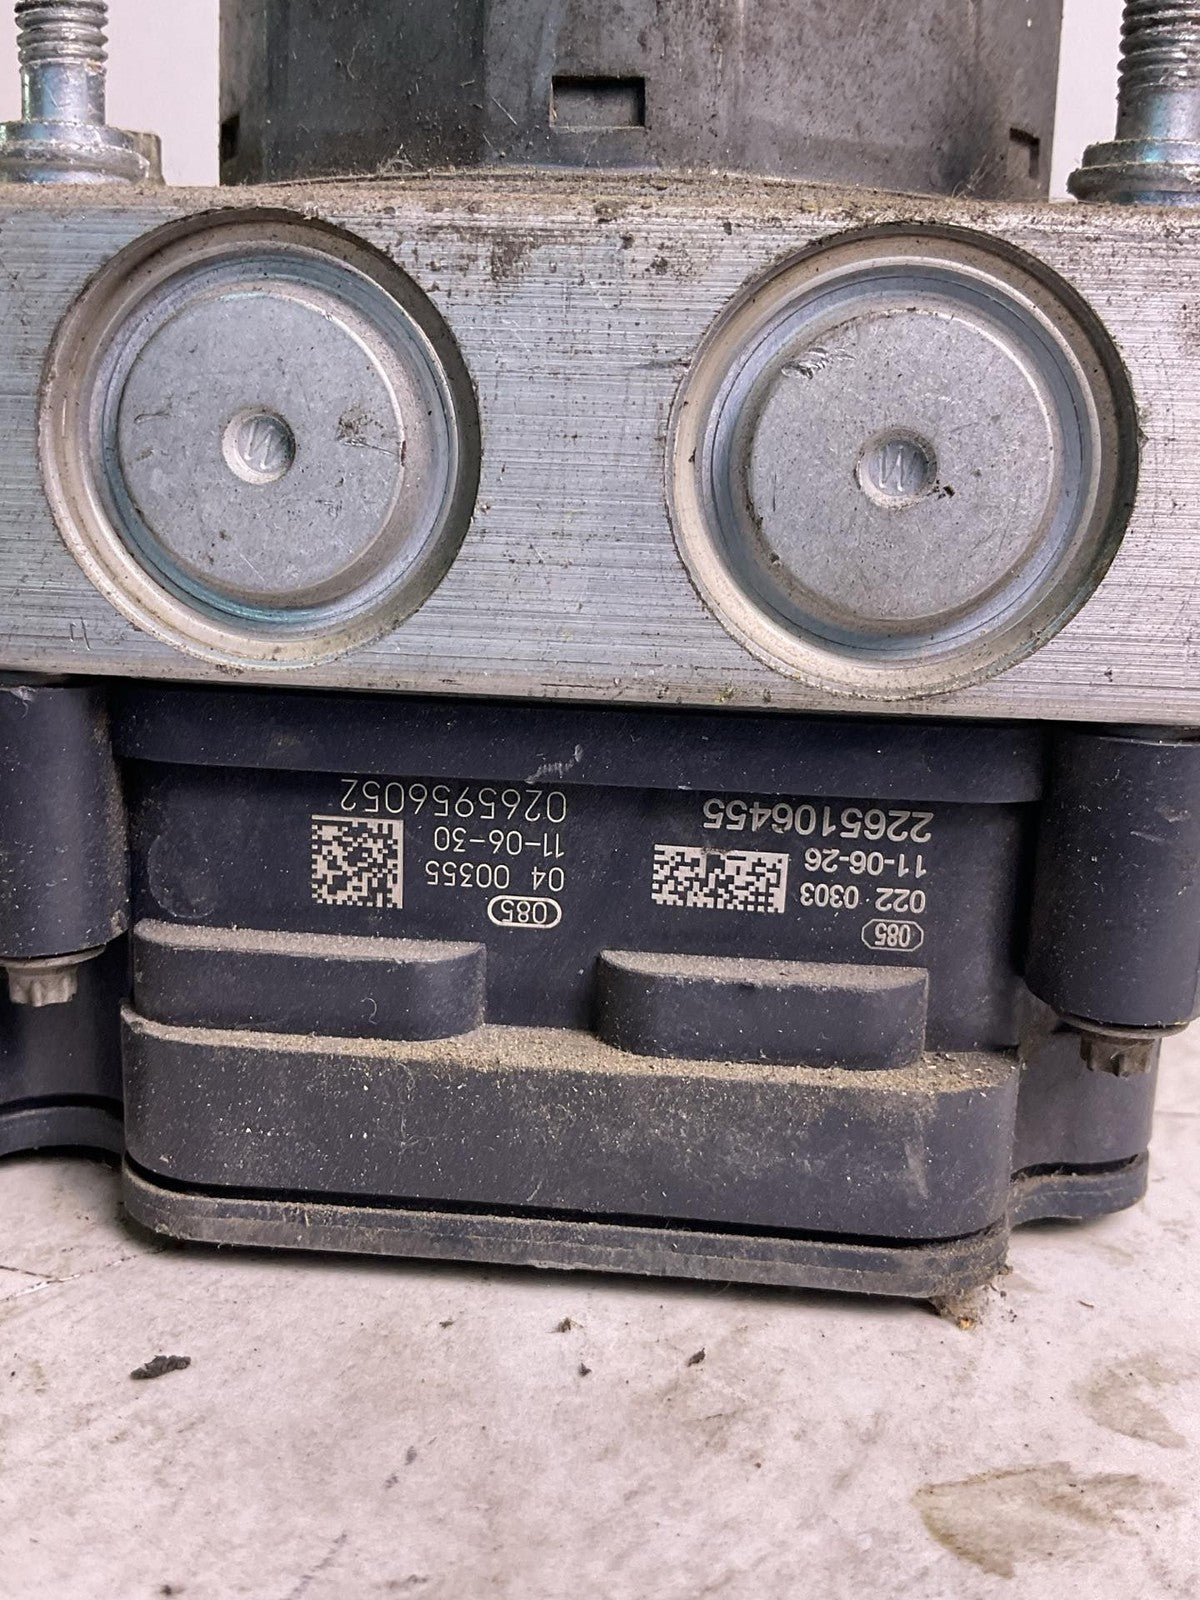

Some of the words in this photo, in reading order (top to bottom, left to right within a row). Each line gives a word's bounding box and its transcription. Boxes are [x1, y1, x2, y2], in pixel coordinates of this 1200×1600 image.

[340, 778, 567, 823] 0265956052
[703, 798, 935, 843] 2265106455
[434, 826, 565, 858] 11-06-30
[425, 860, 510, 889] 00355
[804, 847, 927, 878] 11-06-26
[531, 866, 565, 892] 04
[799, 882, 859, 909] 0303
[874, 887, 927, 914] 022
[501, 899, 548, 924] 085
[874, 922, 911, 948] 085
